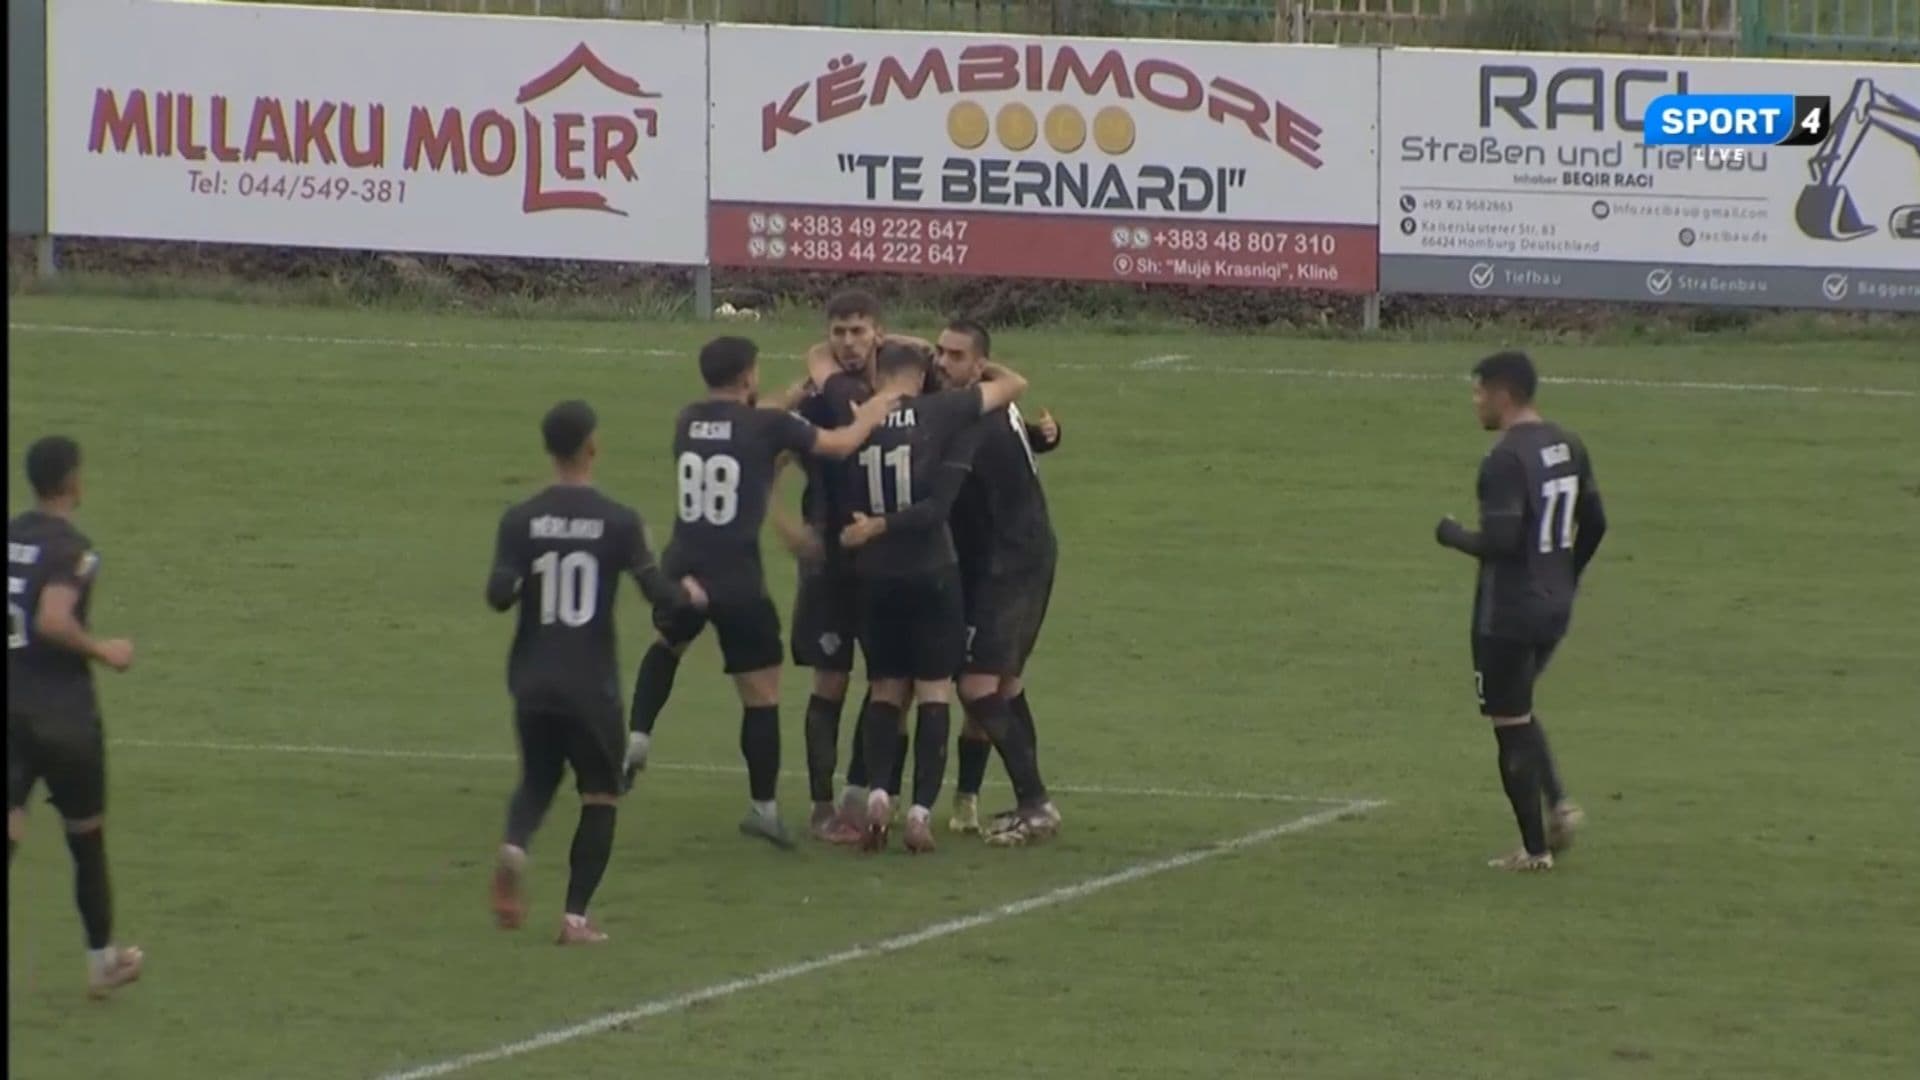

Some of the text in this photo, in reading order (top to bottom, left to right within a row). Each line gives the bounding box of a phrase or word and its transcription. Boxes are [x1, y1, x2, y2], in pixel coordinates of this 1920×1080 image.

[762, 44, 1324, 170] KËMBIMORE
[88, 87, 639, 215] MILLAKU MOLER
[1402, 136, 1545, 165] Straßen
[1558, 140, 1622, 170] und
[188, 169, 406, 203] Tel: 044/549-381
[838, 153, 1246, 213] "TE BERNARDI"
[1562, 171, 1610, 187] BEQIR
[1614, 174, 1654, 188] RACI
[790, 215, 968, 240] +383 49 222 647
[1154, 229, 1335, 255] +383 48 807 310
[790, 240, 968, 264] +383 44 222 647
[1136, 257, 1162, 275] Sh:
[1504, 269, 1561, 286] Tiefbau
[1678, 275, 1768, 292] Straßenbau
[678, 452, 740, 525] 88
[859, 445, 913, 513] 11
[1539, 475, 1579, 553] 77
[532, 551, 598, 627] 10
